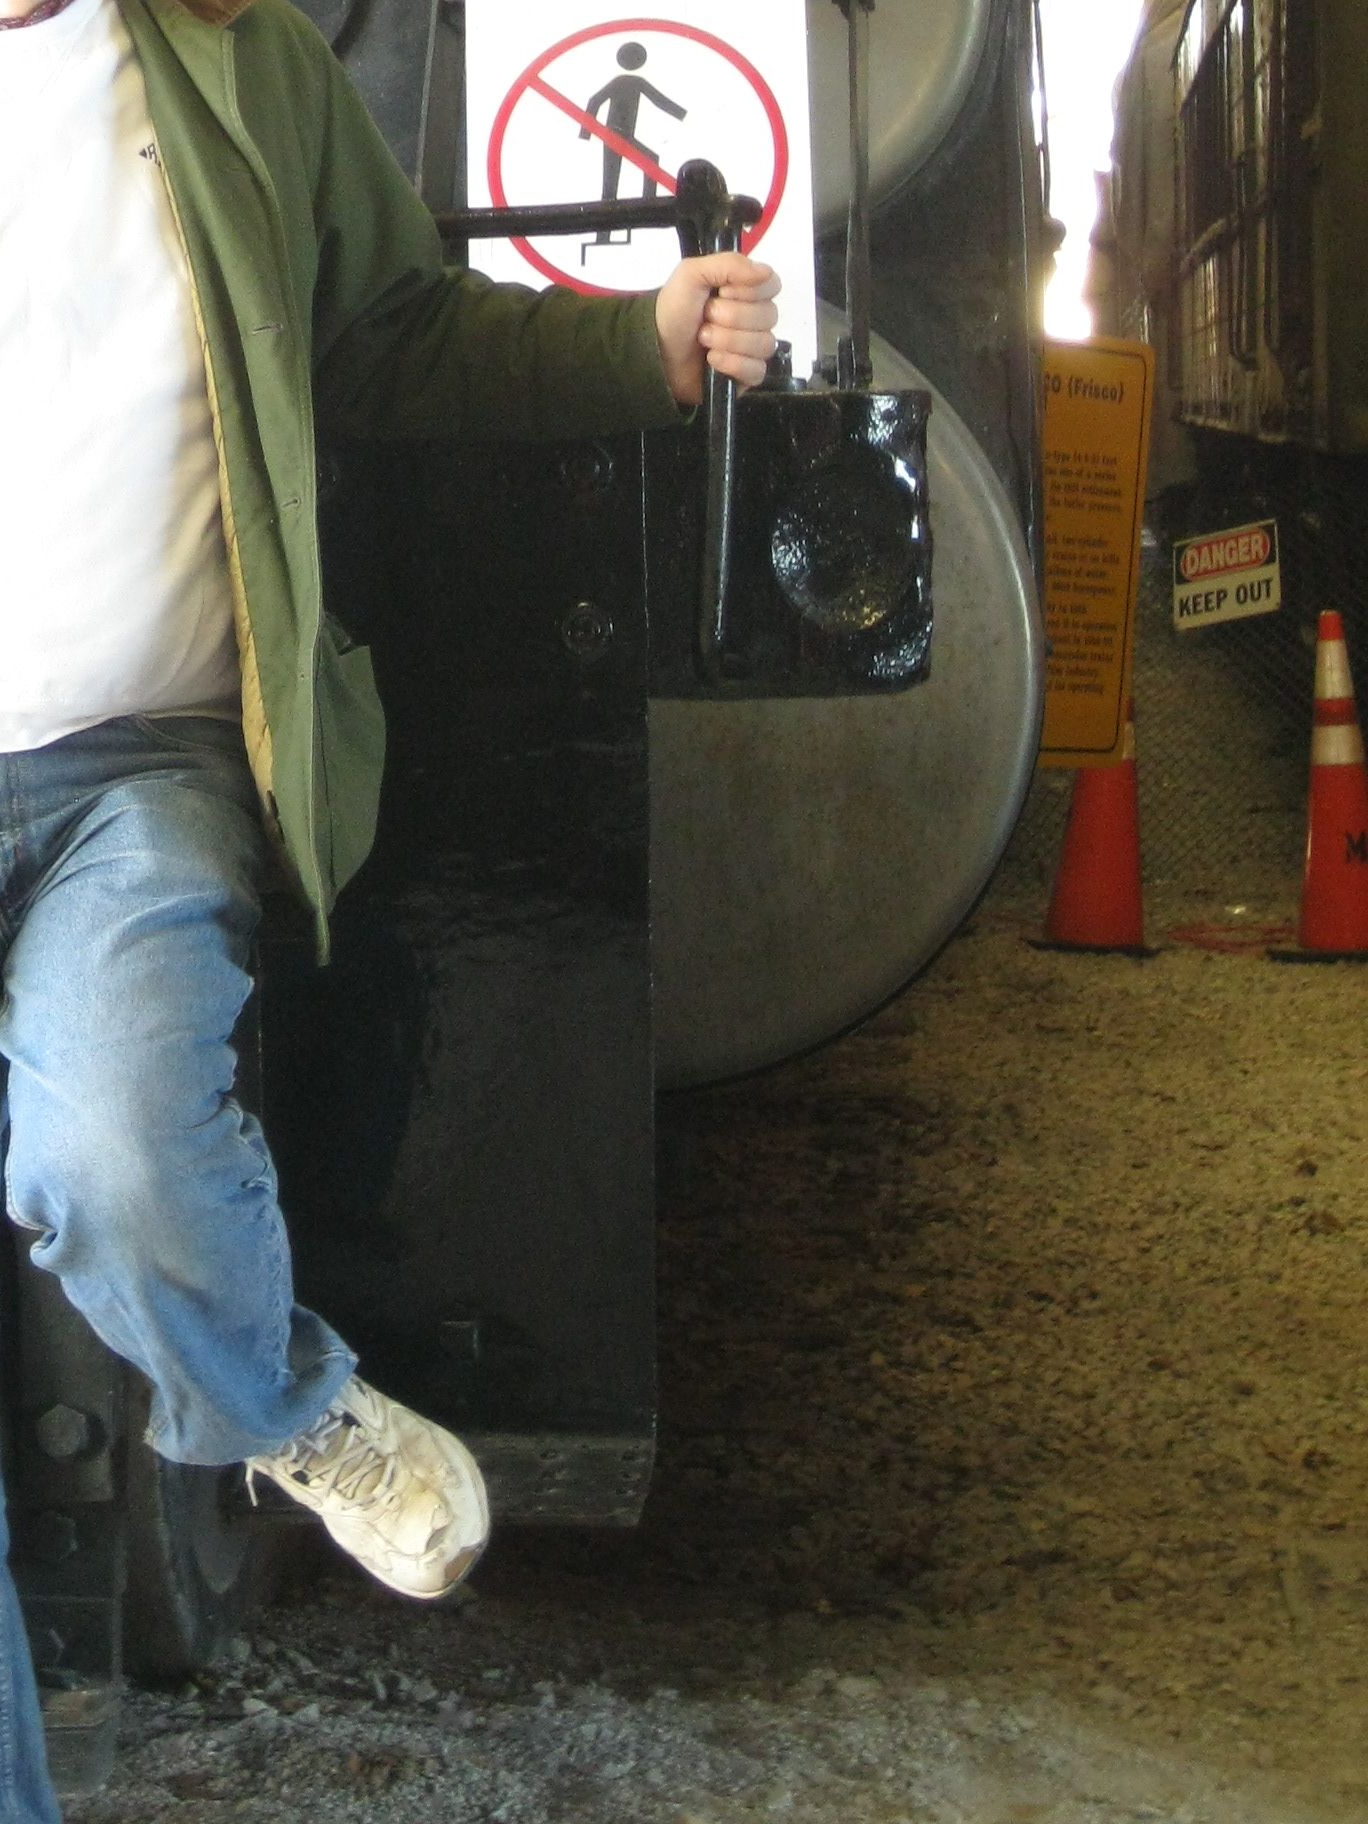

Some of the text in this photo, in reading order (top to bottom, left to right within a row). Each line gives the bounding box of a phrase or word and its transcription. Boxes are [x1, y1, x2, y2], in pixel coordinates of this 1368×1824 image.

[1185, 533, 1263, 576] DANGER
[1178, 578, 1273, 617] KEEP OUT
